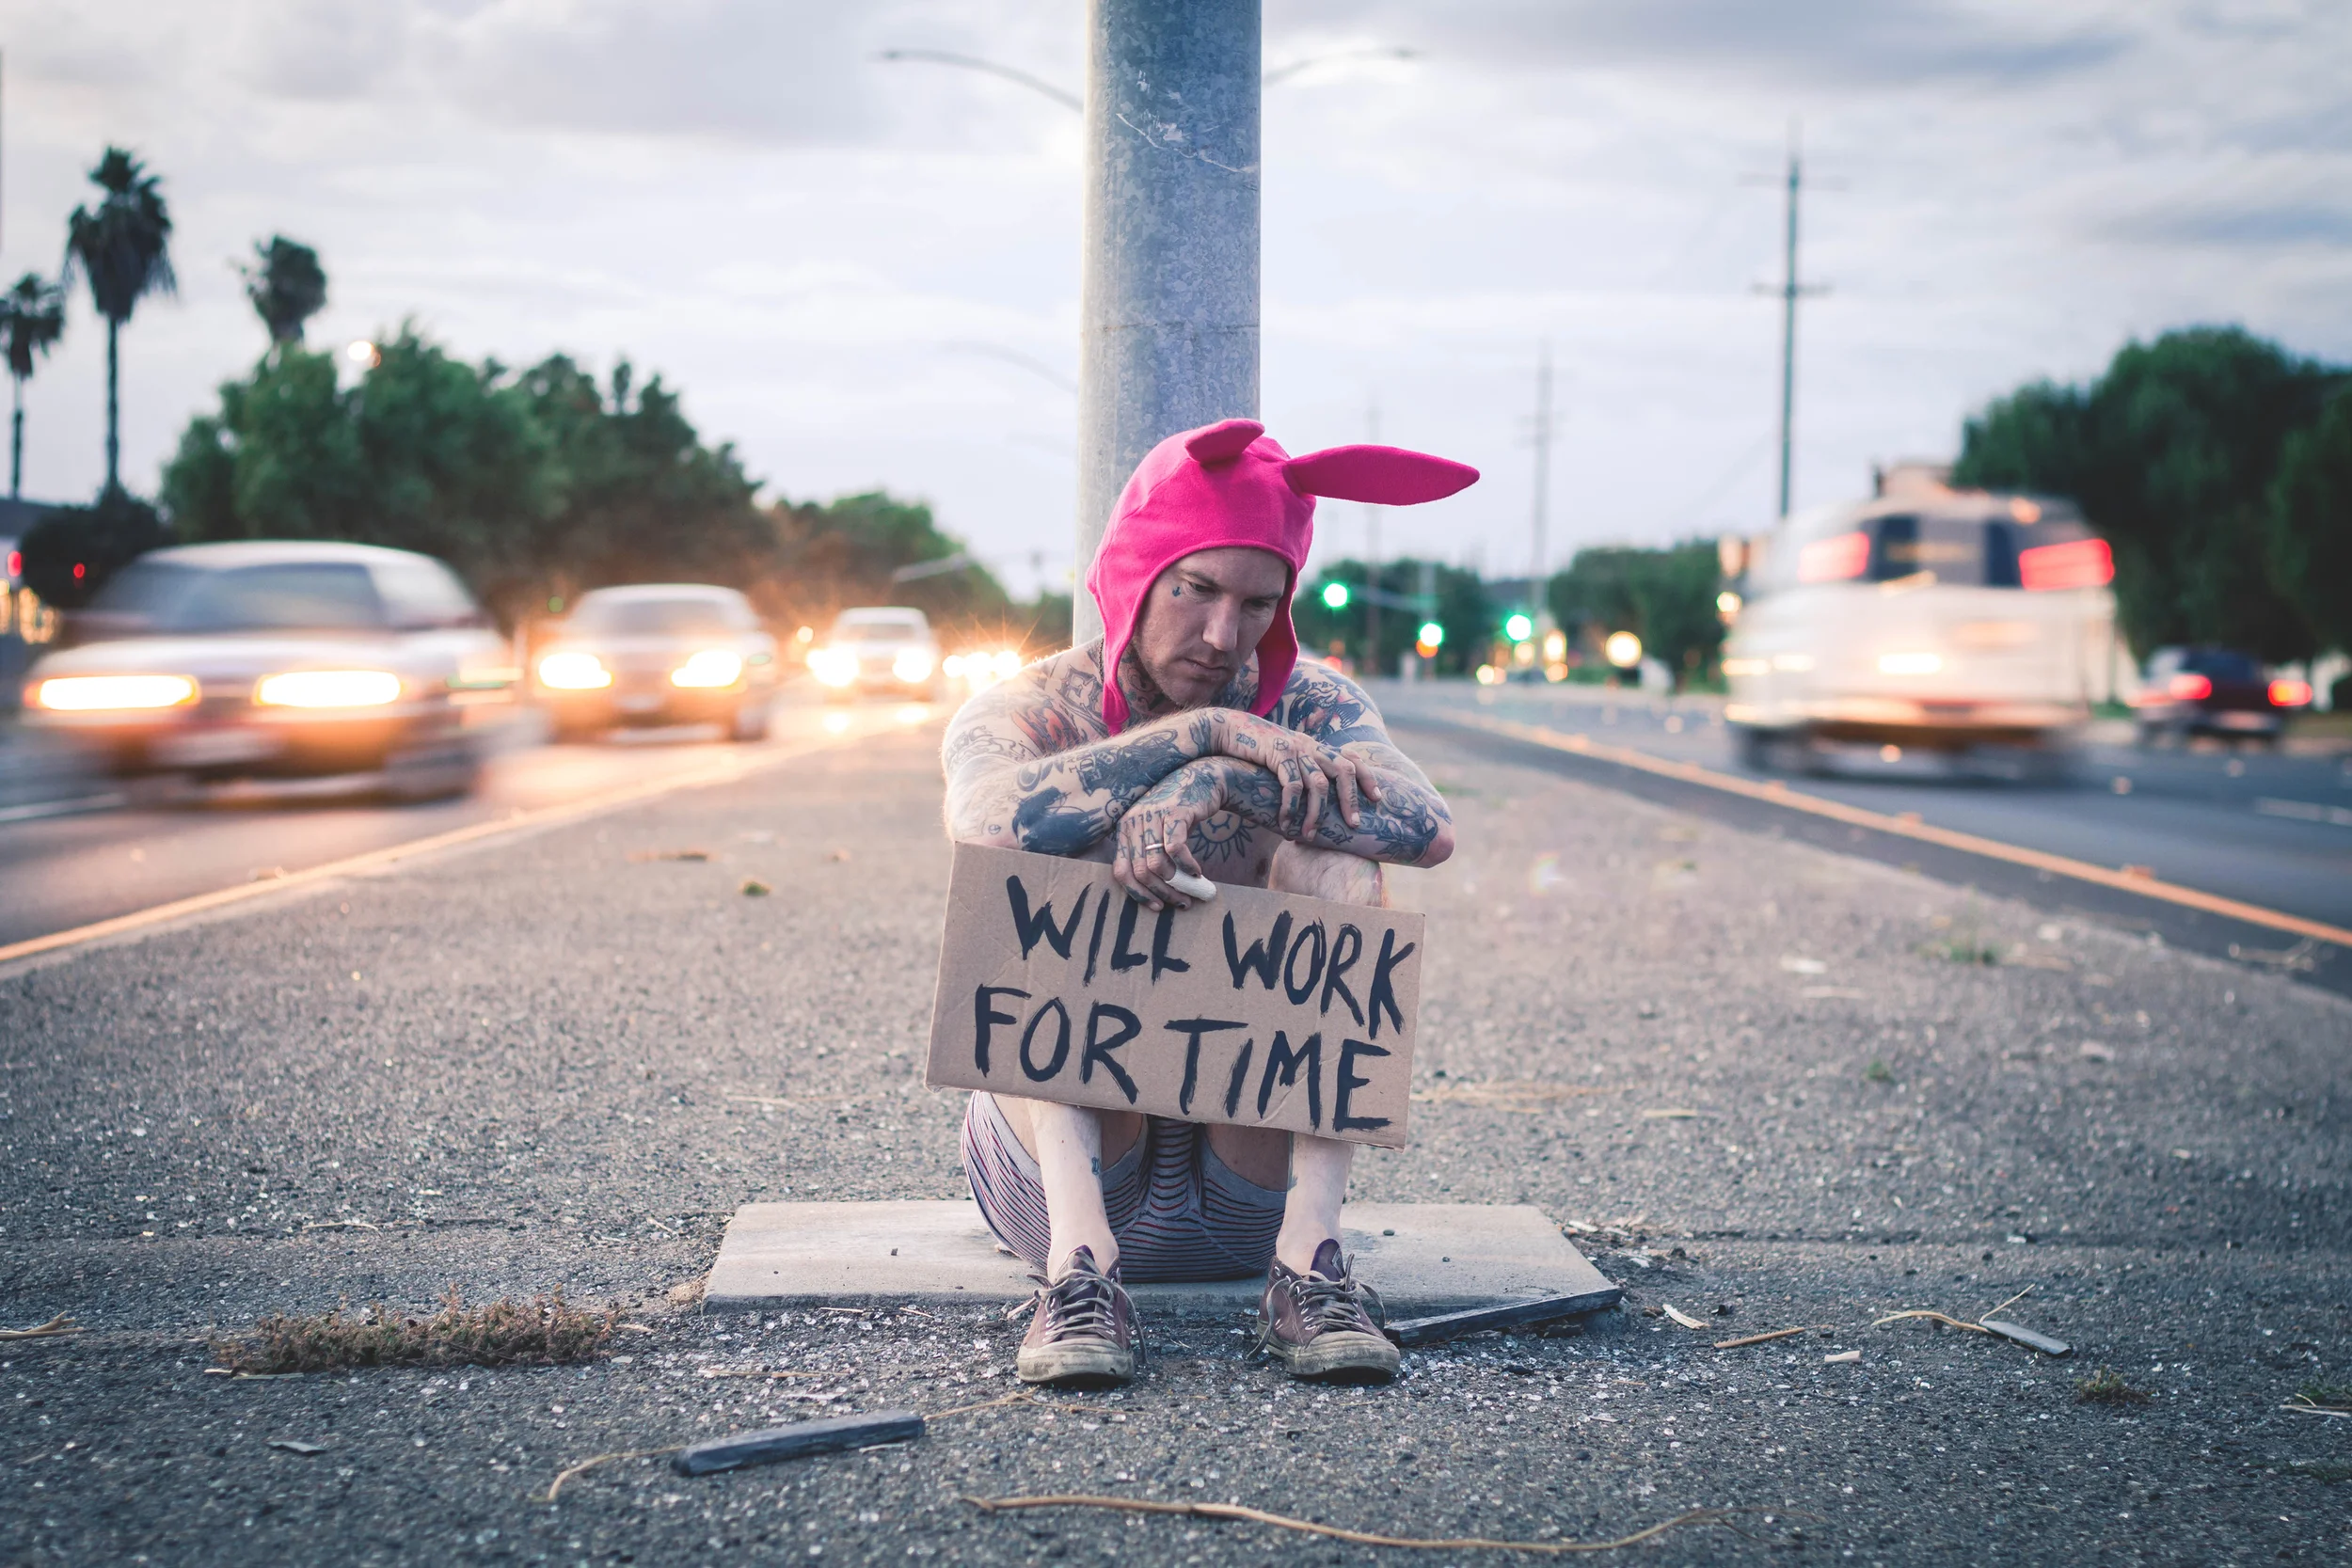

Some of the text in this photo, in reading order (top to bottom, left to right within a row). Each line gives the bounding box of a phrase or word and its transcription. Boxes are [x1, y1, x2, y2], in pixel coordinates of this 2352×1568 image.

[1006, 875, 1415, 1039] WILL WORK
[974, 983, 1391, 1132] FOR TIME
